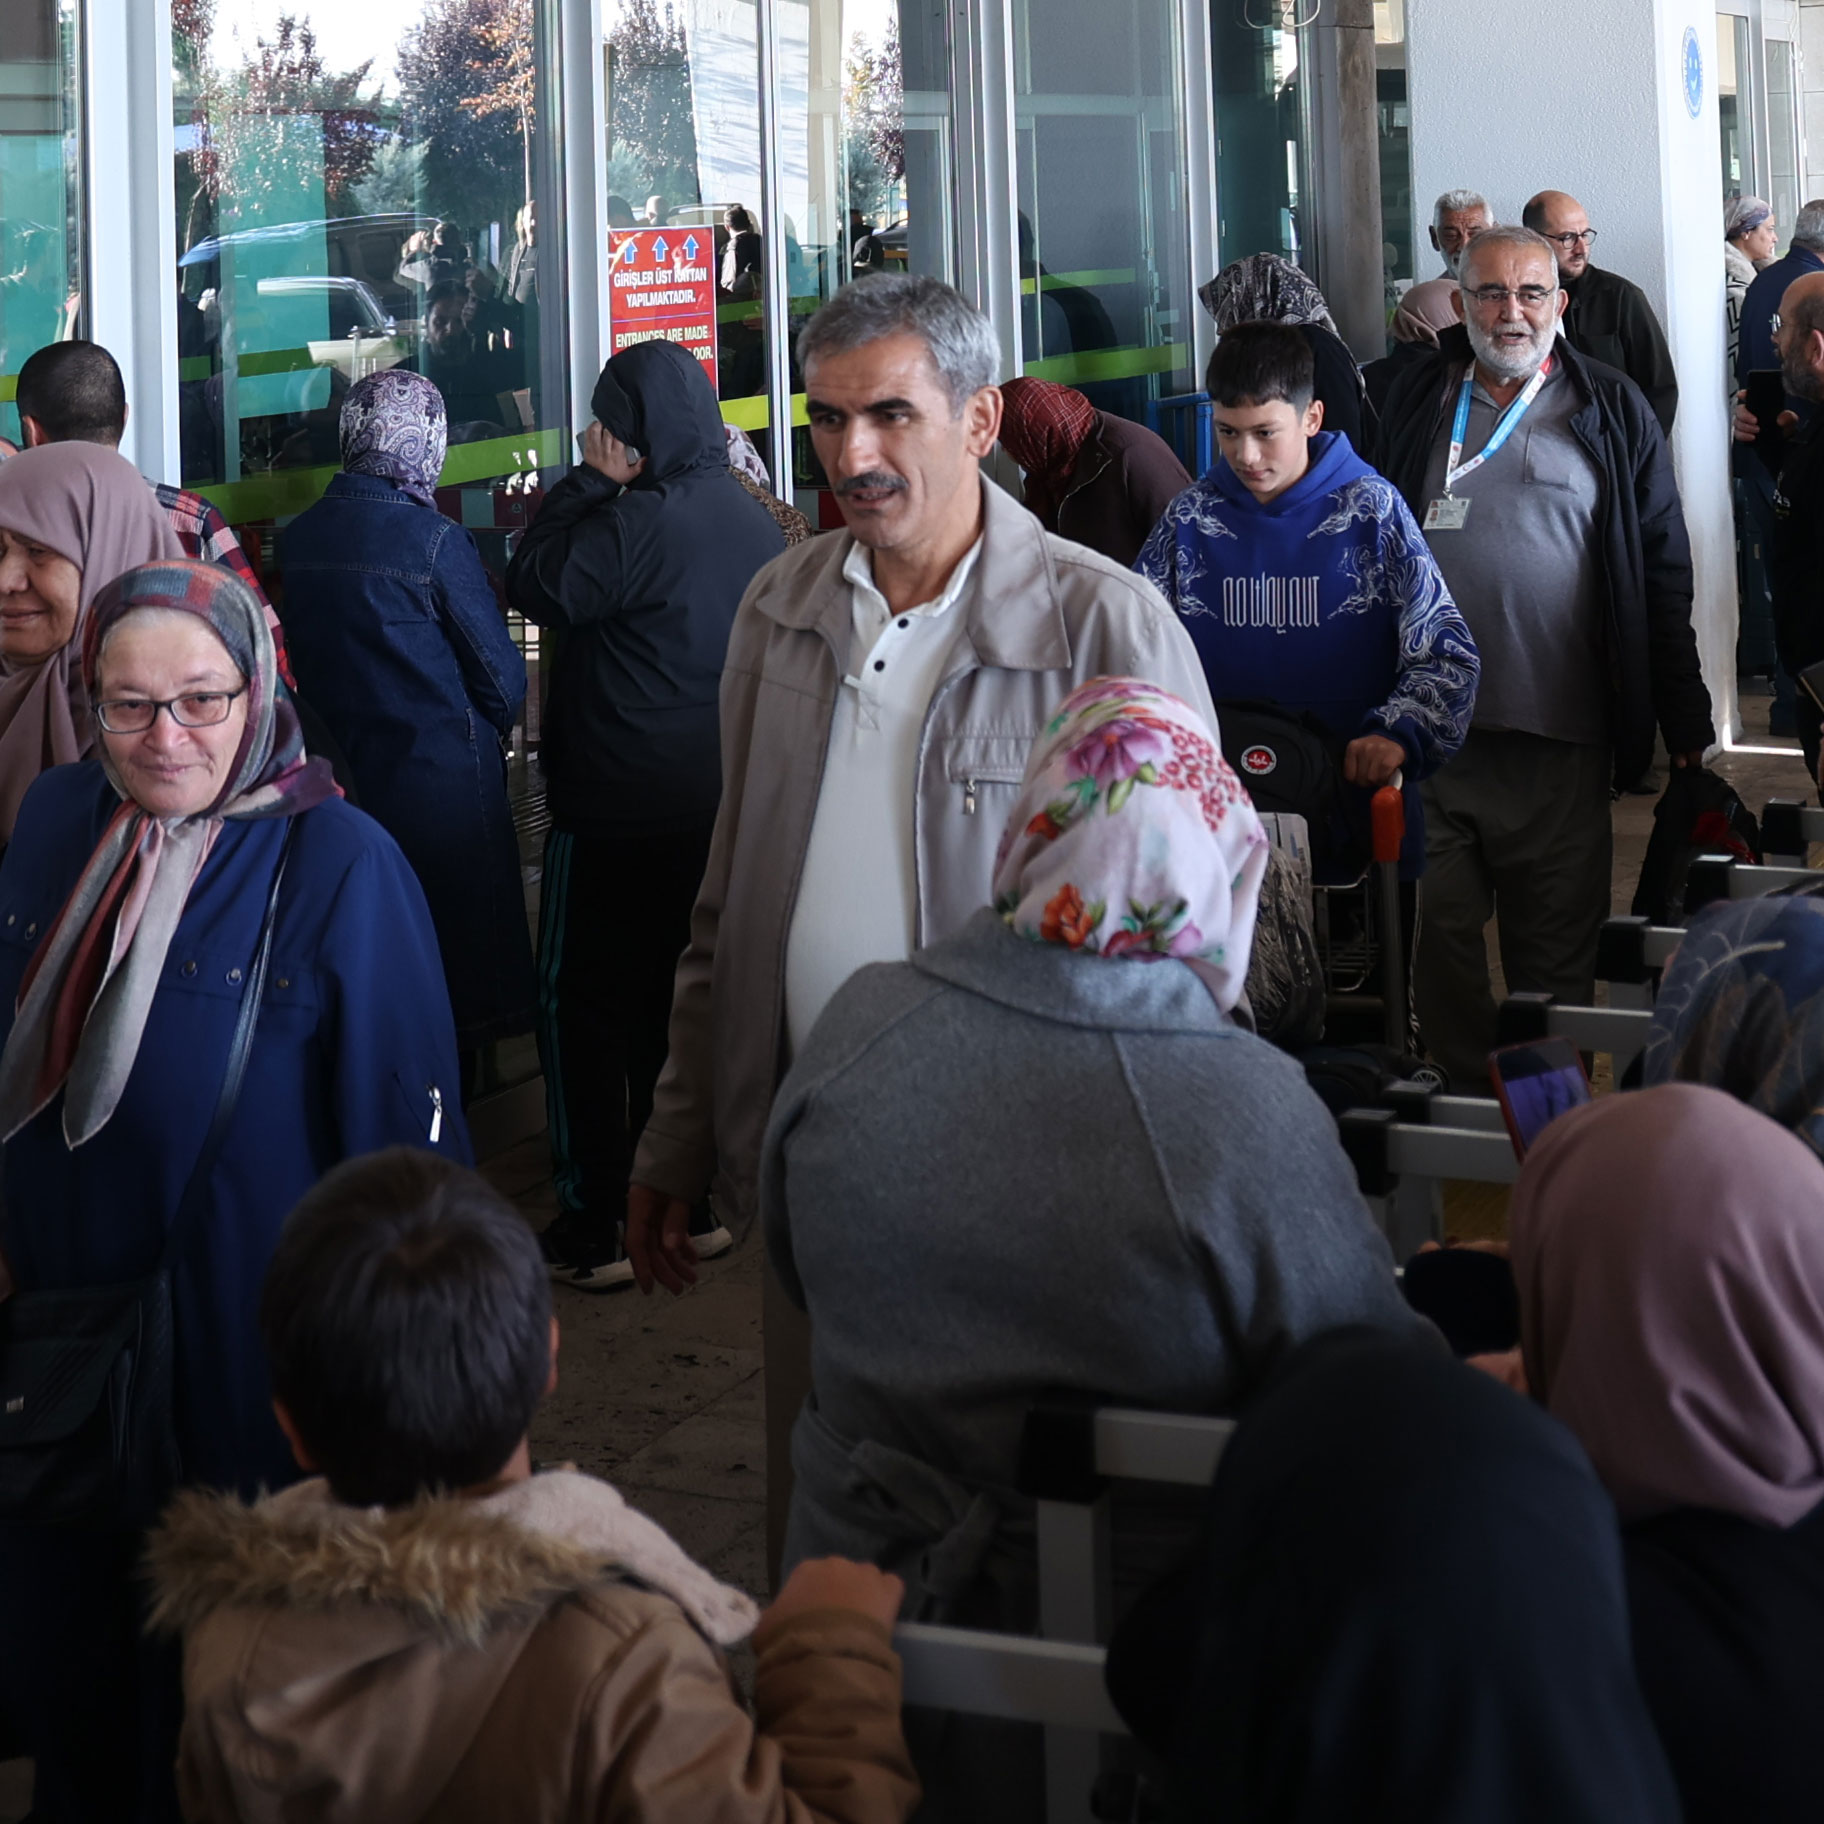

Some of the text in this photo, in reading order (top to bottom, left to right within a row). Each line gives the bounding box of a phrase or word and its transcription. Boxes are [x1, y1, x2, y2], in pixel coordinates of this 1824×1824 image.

[614, 269, 653, 289] GİRİŞLER
[656, 268, 672, 284] ÜST
[626, 289, 696, 308] YAPILMAKTADIR.
[667, 328, 683, 341] ARE
[685, 325, 708, 341] MADE
